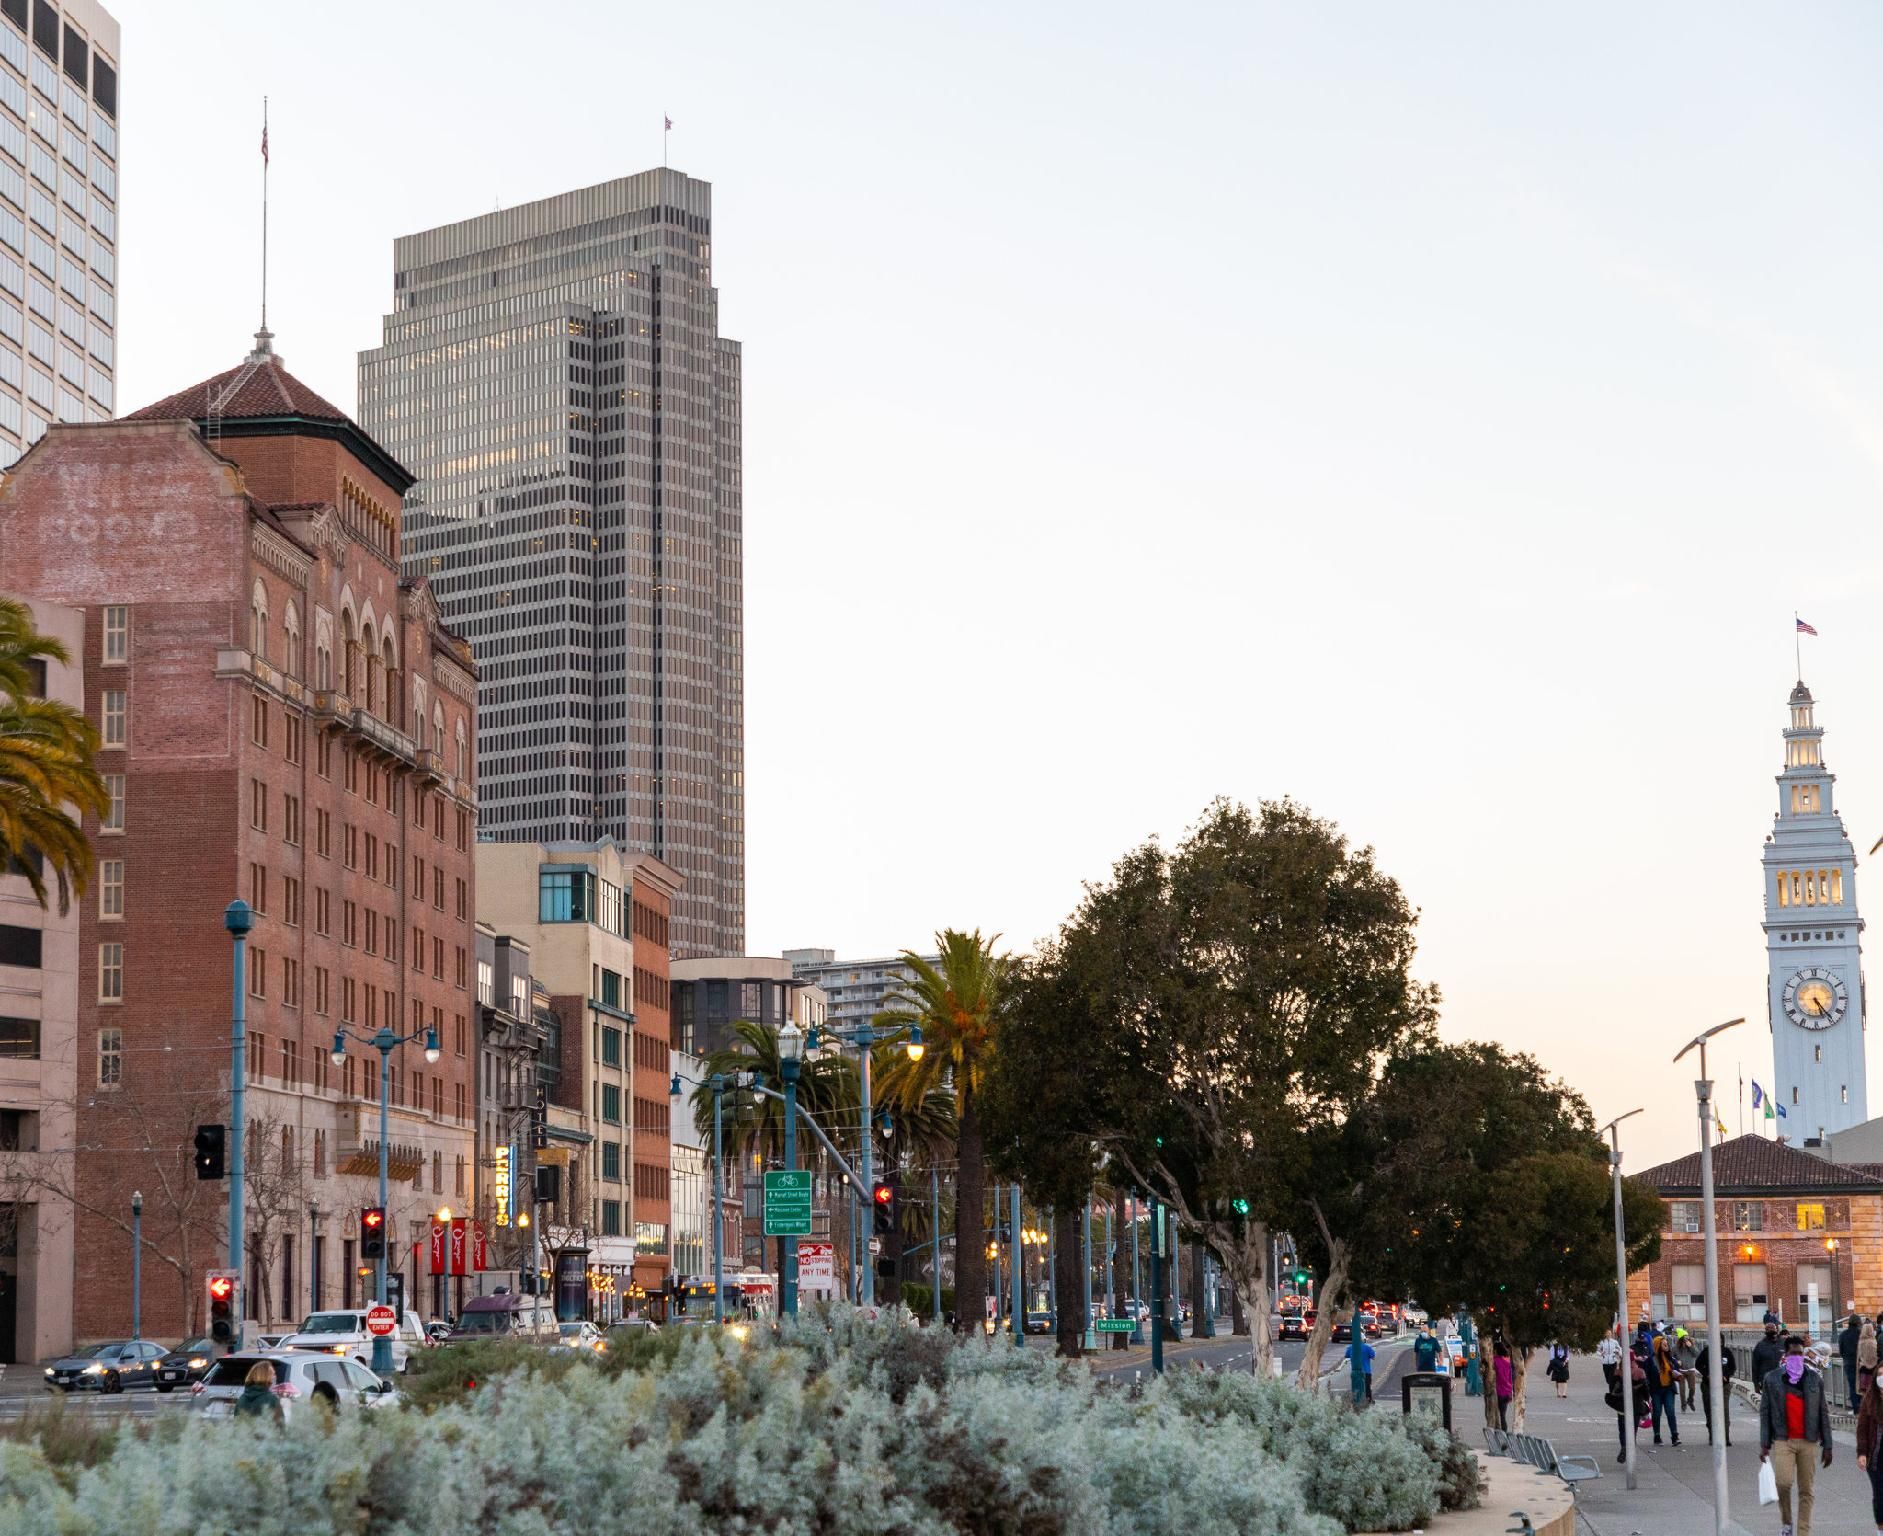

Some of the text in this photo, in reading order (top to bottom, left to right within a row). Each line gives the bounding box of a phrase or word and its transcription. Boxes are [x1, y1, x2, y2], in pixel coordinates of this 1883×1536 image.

[536, 1087, 545, 1147] HOTEL
[802, 1268, 831, 1277] ANY TIME
